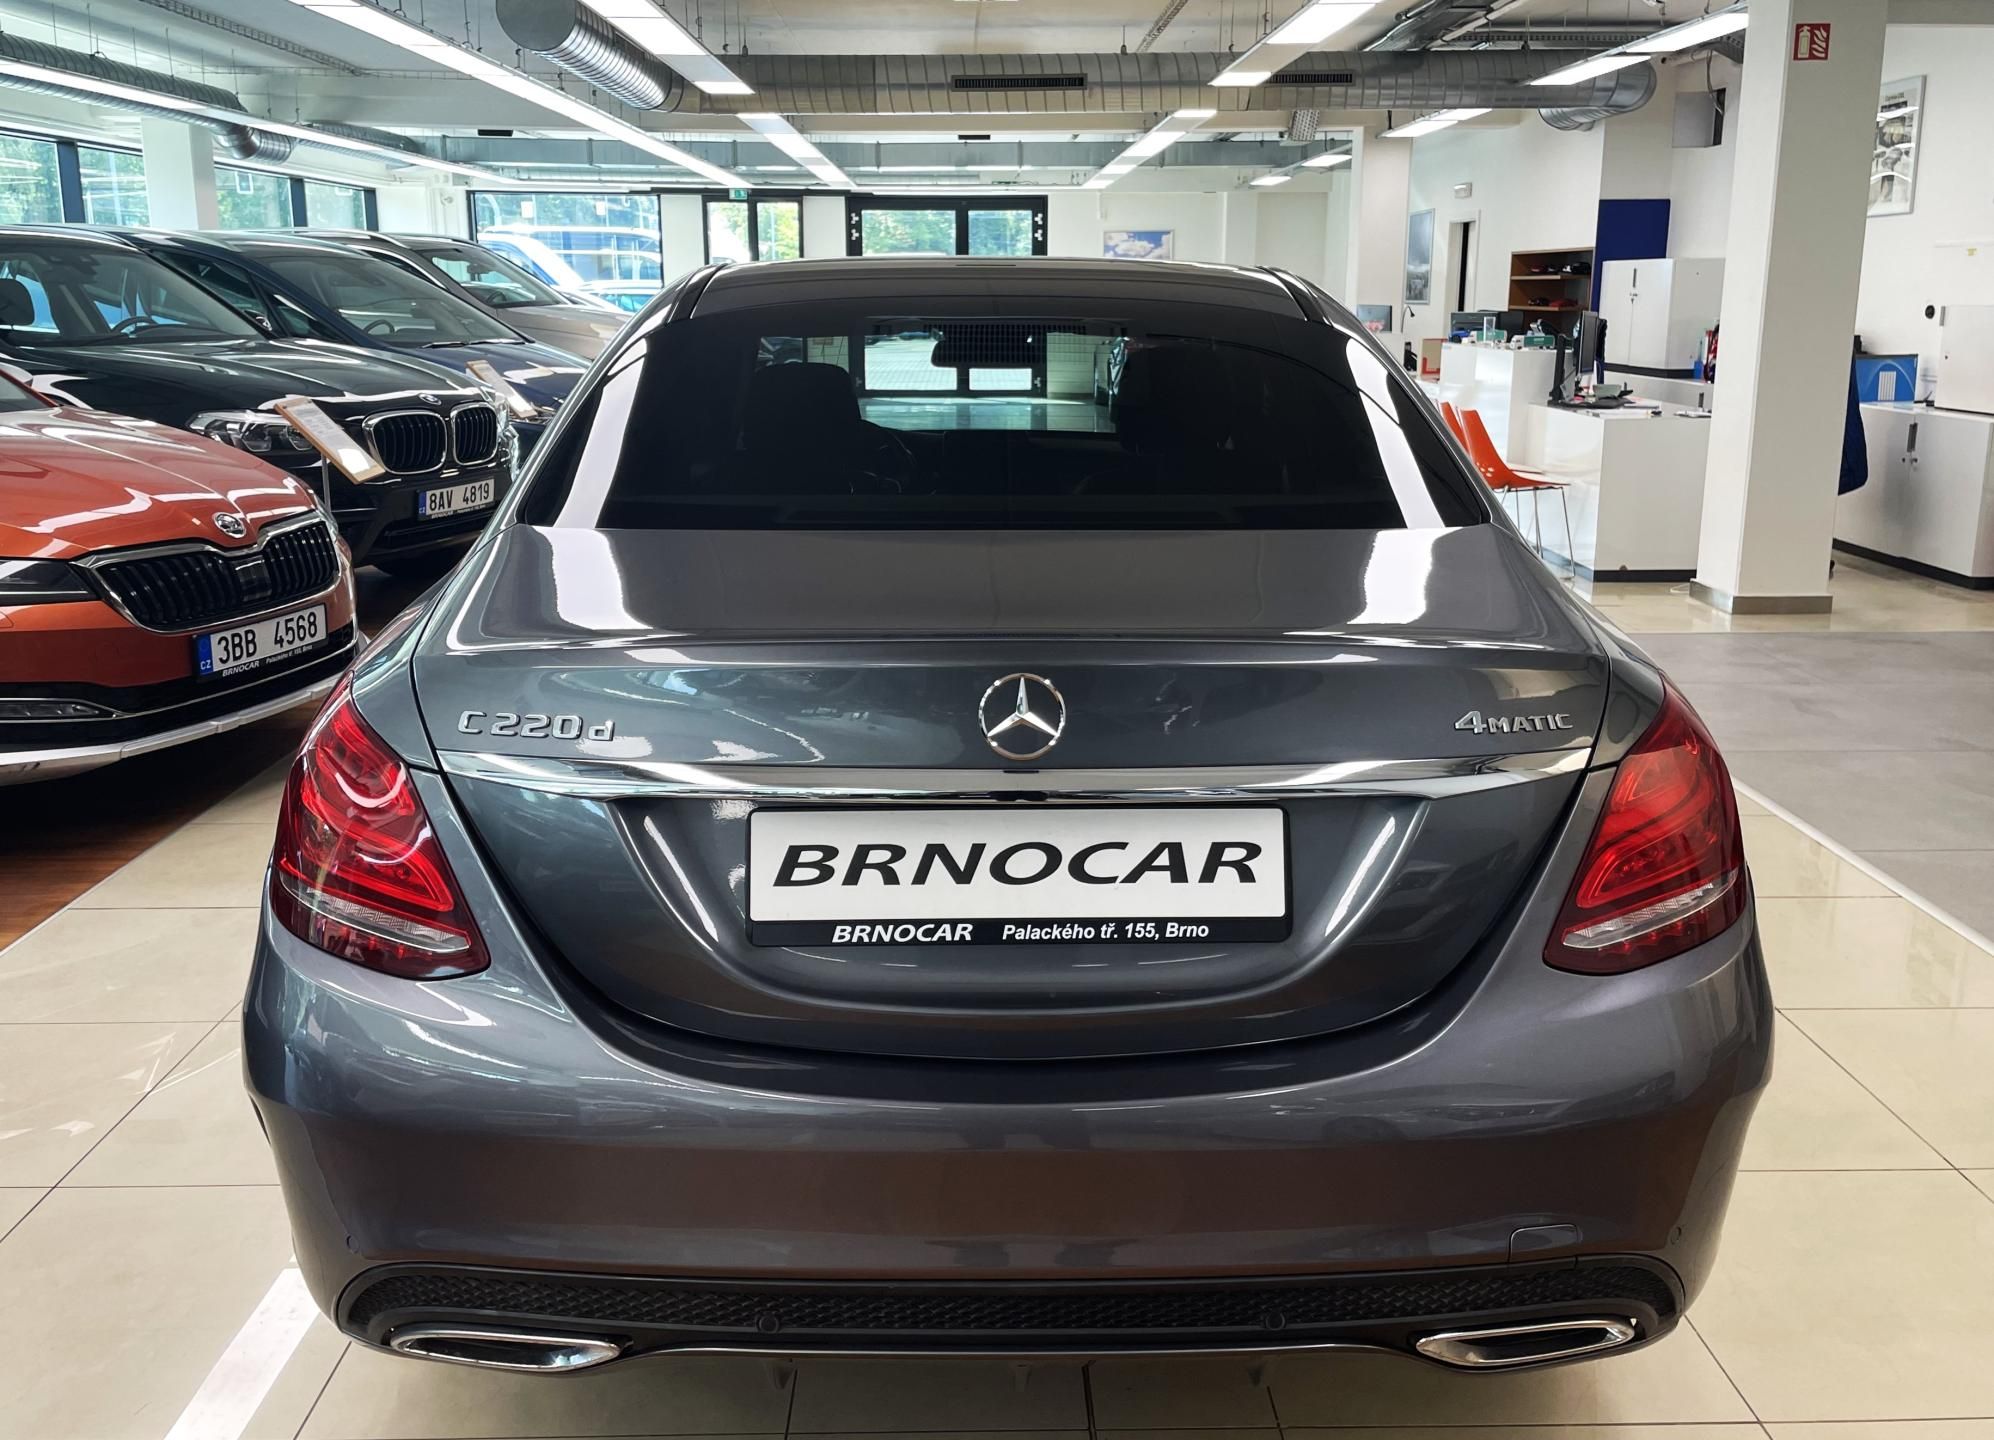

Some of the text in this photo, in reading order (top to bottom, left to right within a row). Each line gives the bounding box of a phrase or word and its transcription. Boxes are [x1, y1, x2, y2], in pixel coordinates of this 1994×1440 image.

[429, 490, 453, 511] 8AV
[463, 482, 490, 505] 4819
[217, 612, 317, 664] 3BB 4568
[200, 660, 211, 670] CZ
[222, 661, 260, 677] BRNOCAR
[1454, 710, 1573, 734] 4MATIC
[772, 841, 1263, 887] BRNOCAR
[831, 922, 1210, 943] BRNOCAR Palackého tř. 155, Brno
